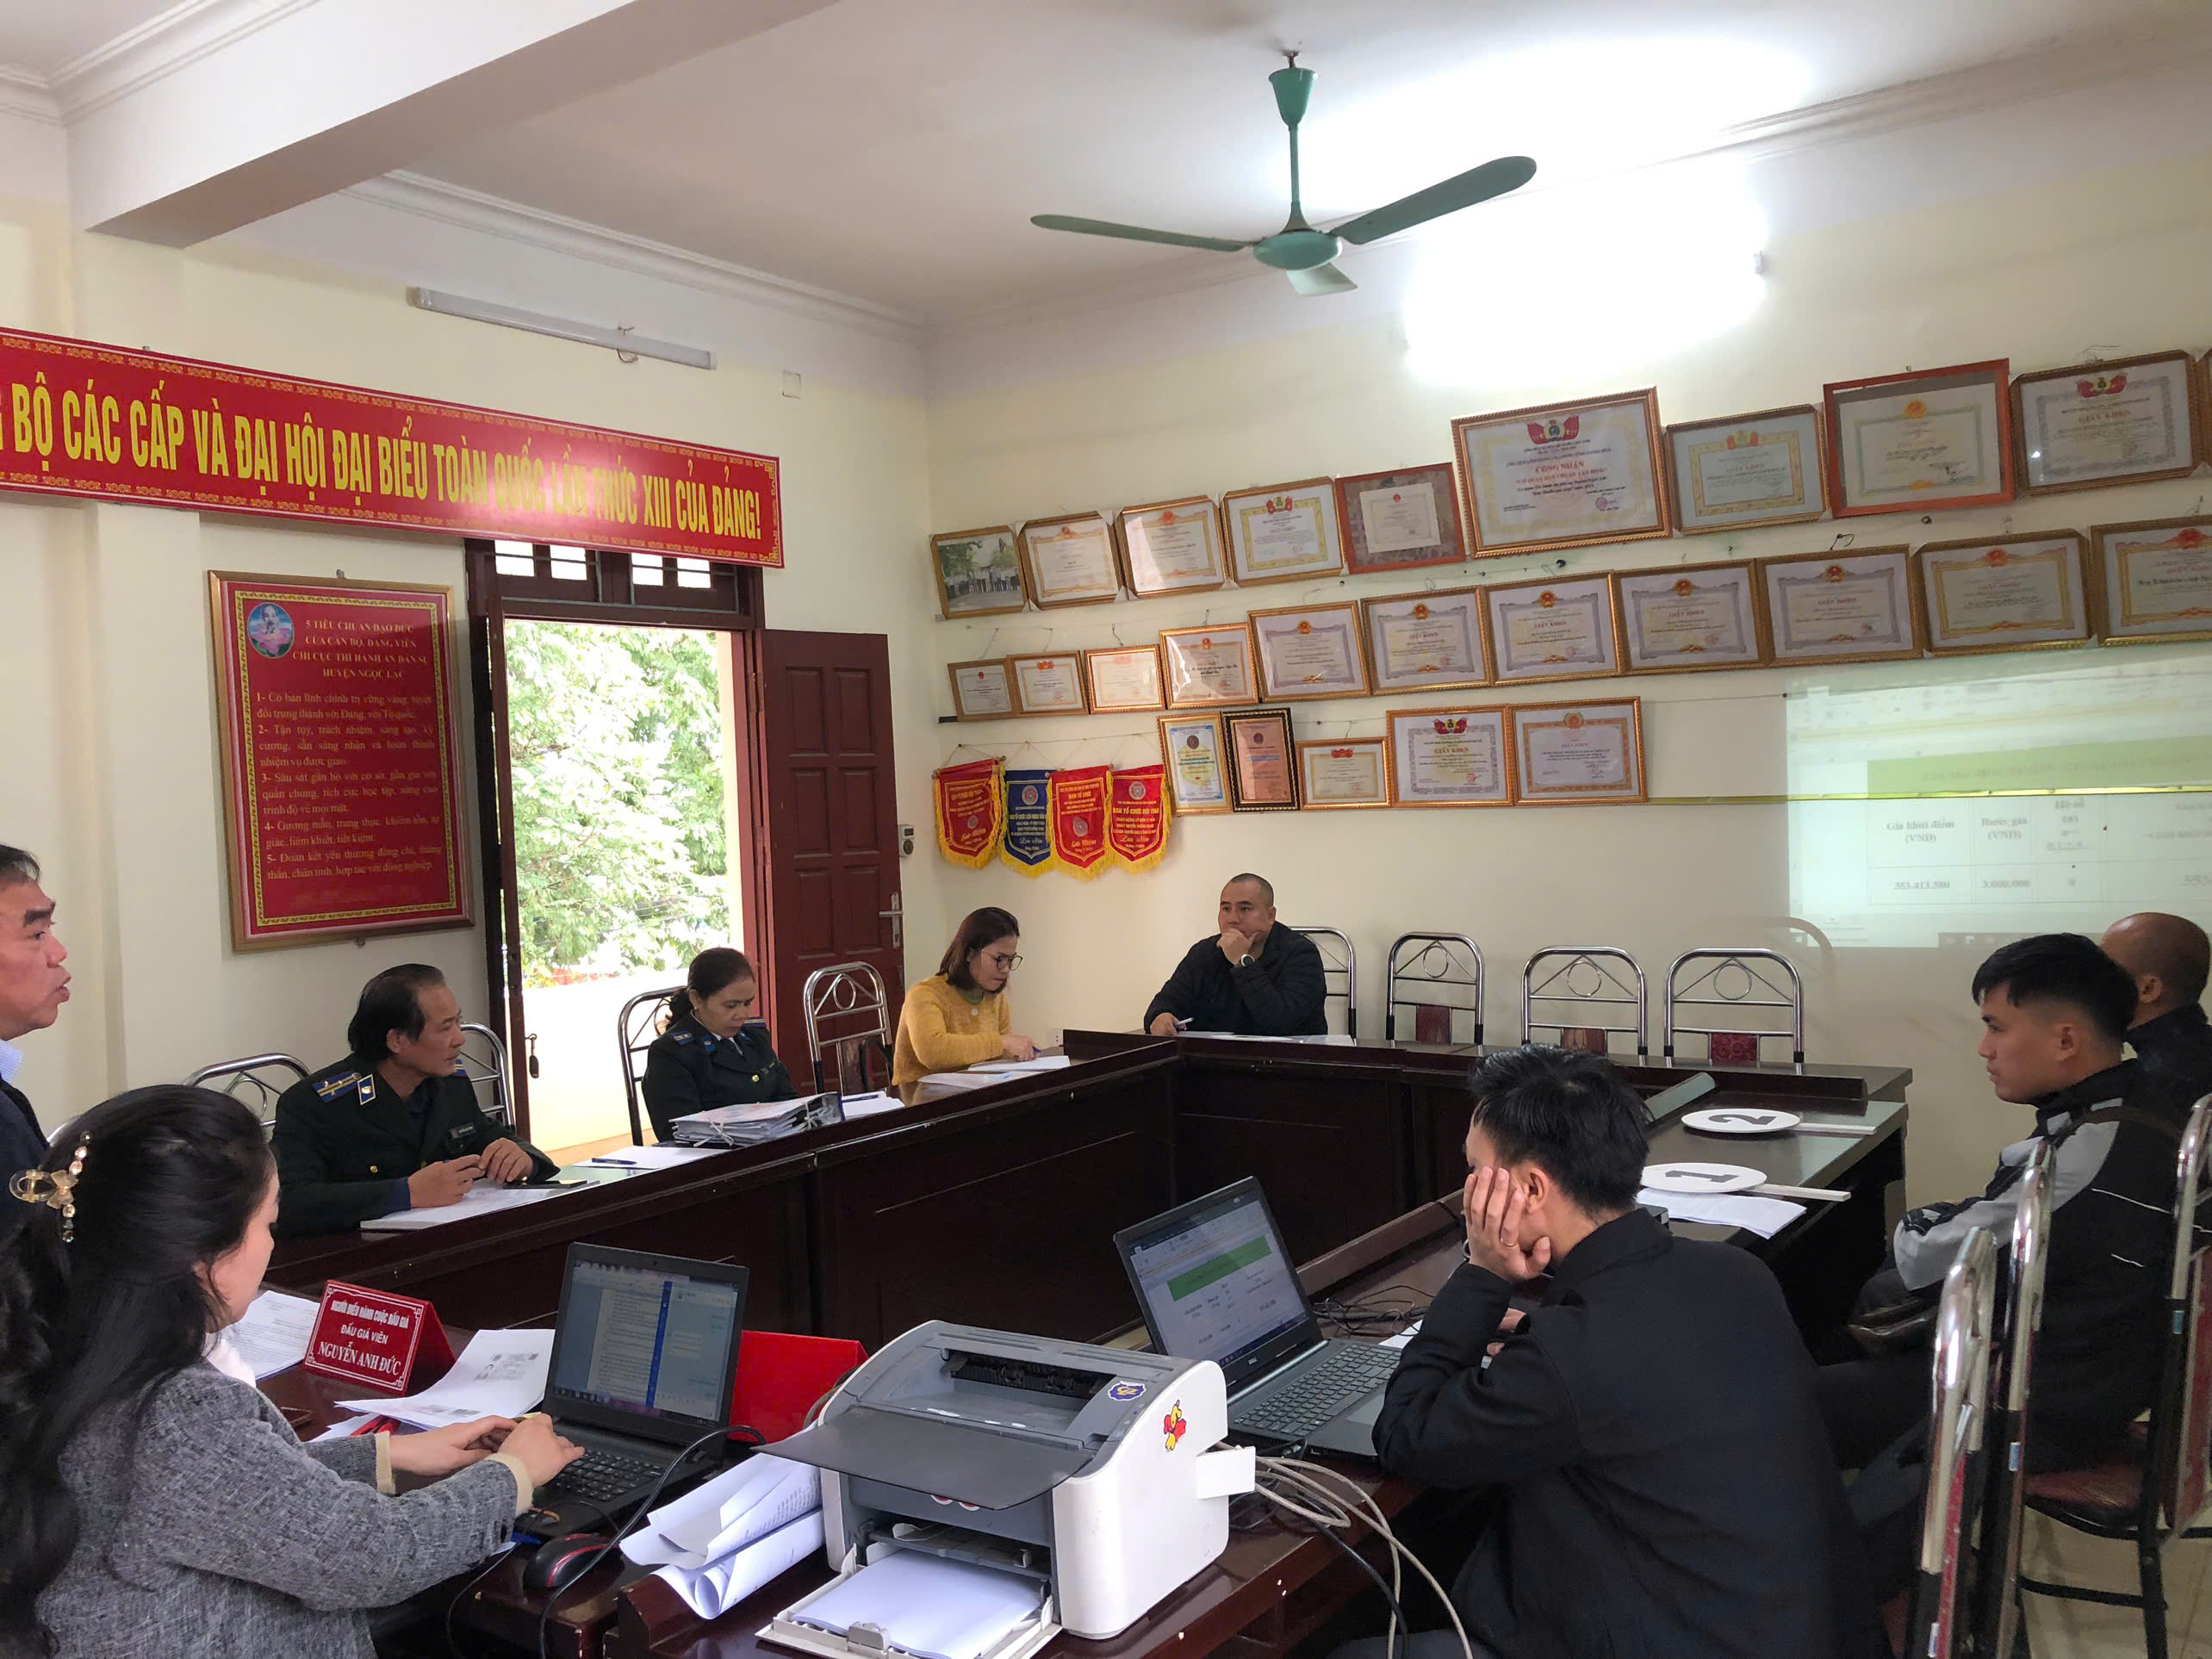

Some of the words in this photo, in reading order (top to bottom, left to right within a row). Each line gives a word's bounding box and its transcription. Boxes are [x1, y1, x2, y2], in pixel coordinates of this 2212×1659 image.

[12, 371, 53, 471] BỘ
[62, 379, 121, 464] CÁC
[130, 380, 184, 470] CẤP
[192, 398, 230, 477] VÀ
[234, 415, 279, 495] ĐẠI
[284, 412, 326, 501] HỘI
[332, 429, 372, 506] ĐẠI
[377, 415, 428, 500] BIỂU
[433, 436, 488, 506] TOÀN
[494, 438, 545, 513] QUỐC
[550, 444, 588, 517] LẦN
[643, 475, 673, 529] XIII
[675, 459, 710, 535] CỦA
[712, 465, 761, 541] ĐẢNG!
[258, 724, 269, 734] 2-
[261, 773, 272, 783] 3-
[264, 821, 275, 831] 4-
[267, 854, 277, 865] 5-
[1708, 1113, 1777, 1126] 2
[1665, 1170, 1740, 1184] 1
[374, 1308, 388, 1326] CUỘC
[340, 1321, 357, 1337] ĐẤU
[357, 1327, 370, 1341] GIÁ
[371, 1329, 389, 1345] VIÊN
[318, 1341, 358, 1364] NGUYỄN
[358, 1352, 379, 1370] ANH
[379, 1357, 401, 1376] ĐỨC
